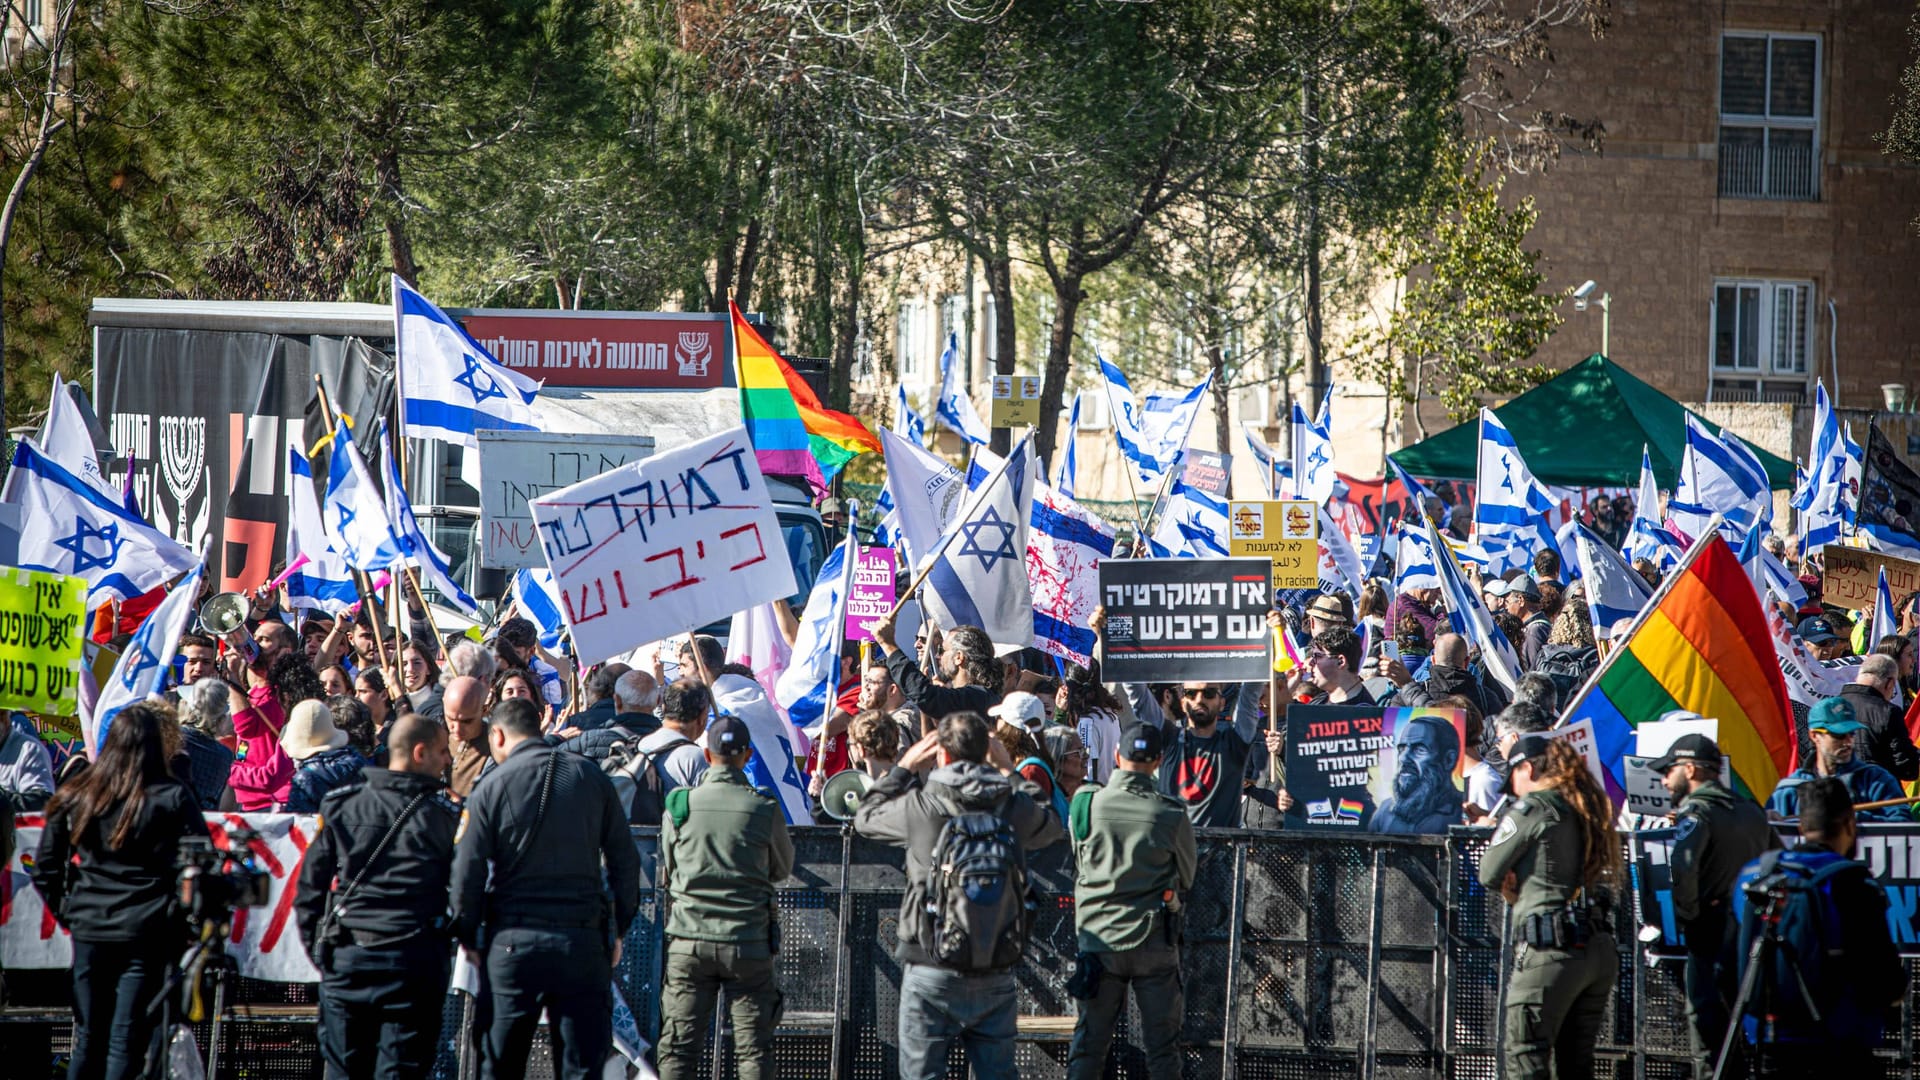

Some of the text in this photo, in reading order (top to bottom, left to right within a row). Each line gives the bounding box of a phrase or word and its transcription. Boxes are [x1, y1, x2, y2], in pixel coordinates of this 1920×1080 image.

[542, 337, 600, 369] לאיכות
[606, 342, 668, 370] התנועה
[1235, 522, 1262, 532] מאיר
[1246, 541, 1303, 552] לא לגזענות
[562, 522, 767, 625] כיבוש
[856, 572, 888, 583] זה הבי
[1286, 575, 1316, 587] racism
[35, 581, 62, 613] אין
[1106, 583, 1227, 610] דמוקרטיה
[1232, 582, 1267, 610] אין
[849, 602, 889, 614] של כולנו
[1139, 615, 1266, 640] עם כיבוש
[47, 664, 71, 700] יש
[1305, 717, 1383, 740] אבי מעוז,
[1297, 735, 1394, 757] אתה ברשימה
[1316, 754, 1378, 772] השחורה
[1329, 771, 1369, 788] שלנו!
